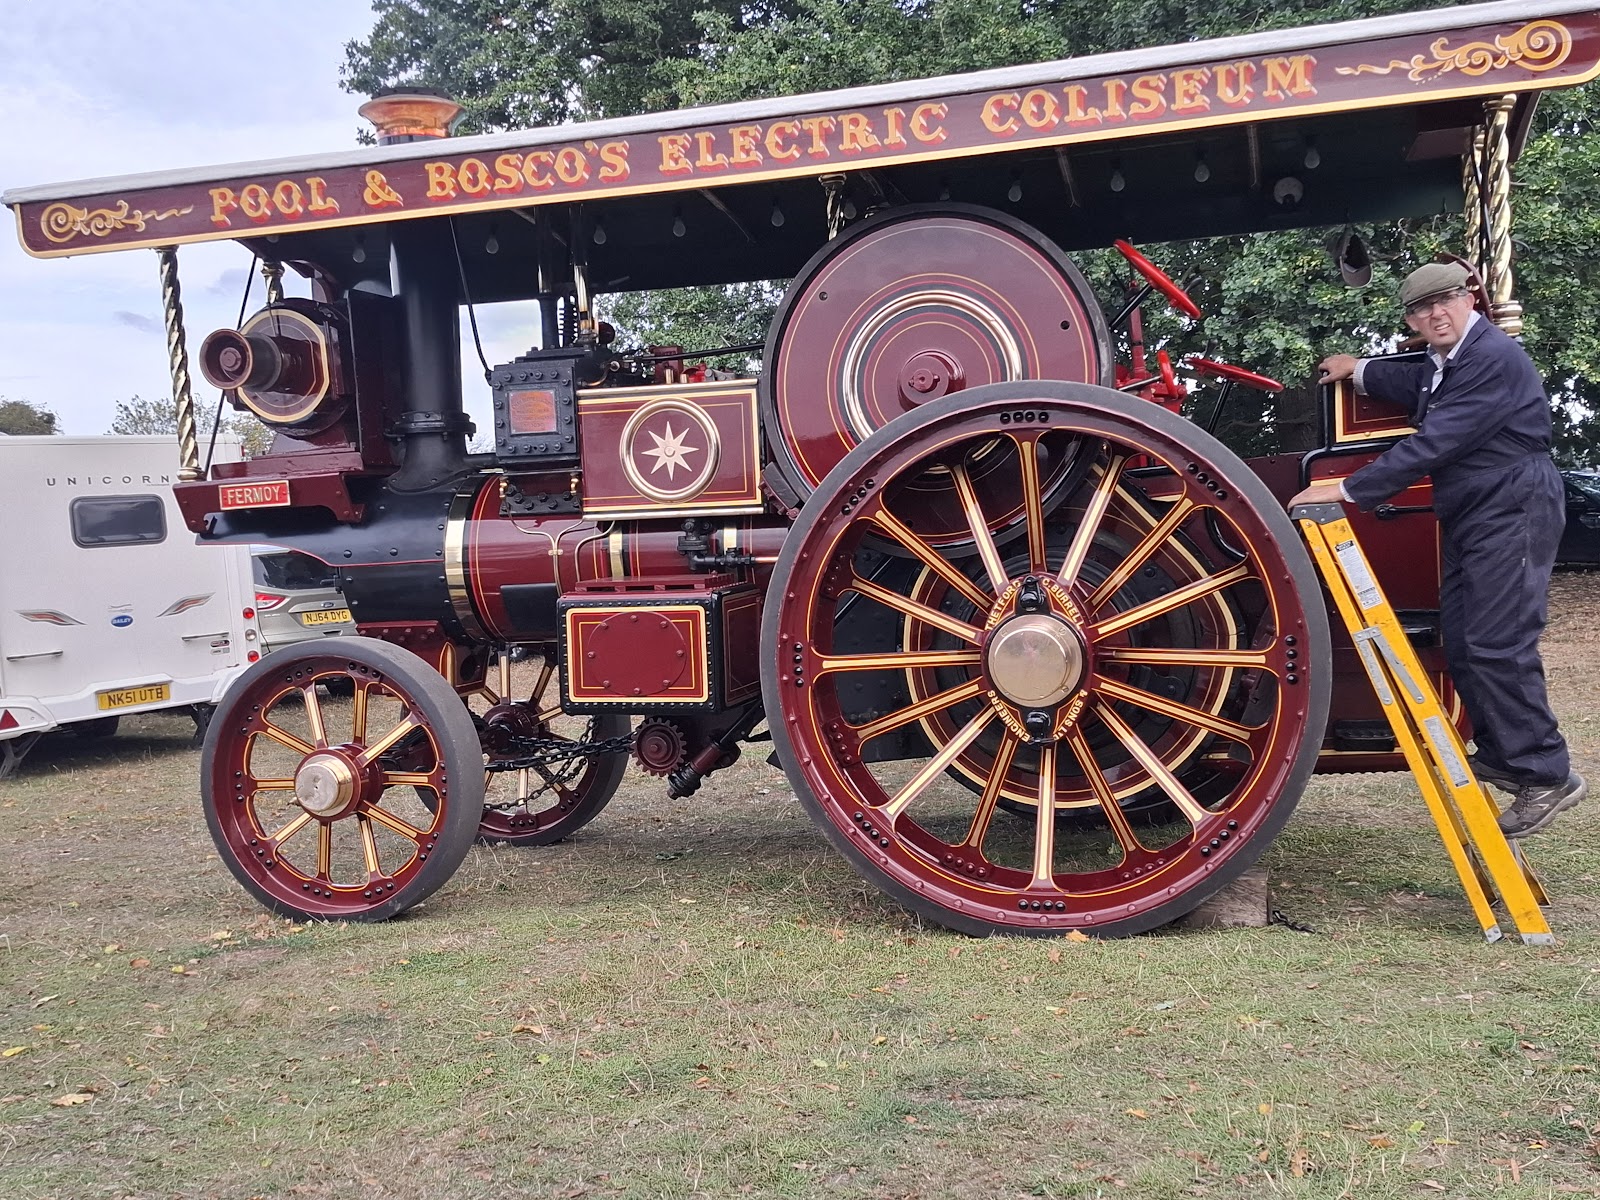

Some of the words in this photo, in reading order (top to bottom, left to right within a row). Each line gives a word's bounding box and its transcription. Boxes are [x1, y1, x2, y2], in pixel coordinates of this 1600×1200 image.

[208, 178, 340, 228] POOL
[363, 170, 404, 208] &
[424, 140, 631, 202] BOSCO'S
[657, 102, 949, 176] ELECTRIC
[979, 54, 1319, 139] COLISEUM
[46, 475, 170, 487] UNICORN
[227, 486, 280, 505] FERMOY
[330, 611, 347, 621] DYG
[984, 580, 1021, 631] THETFORD
[987, 689, 1031, 743] ENGINEERS
[1065, 699, 1084, 728] SONS
